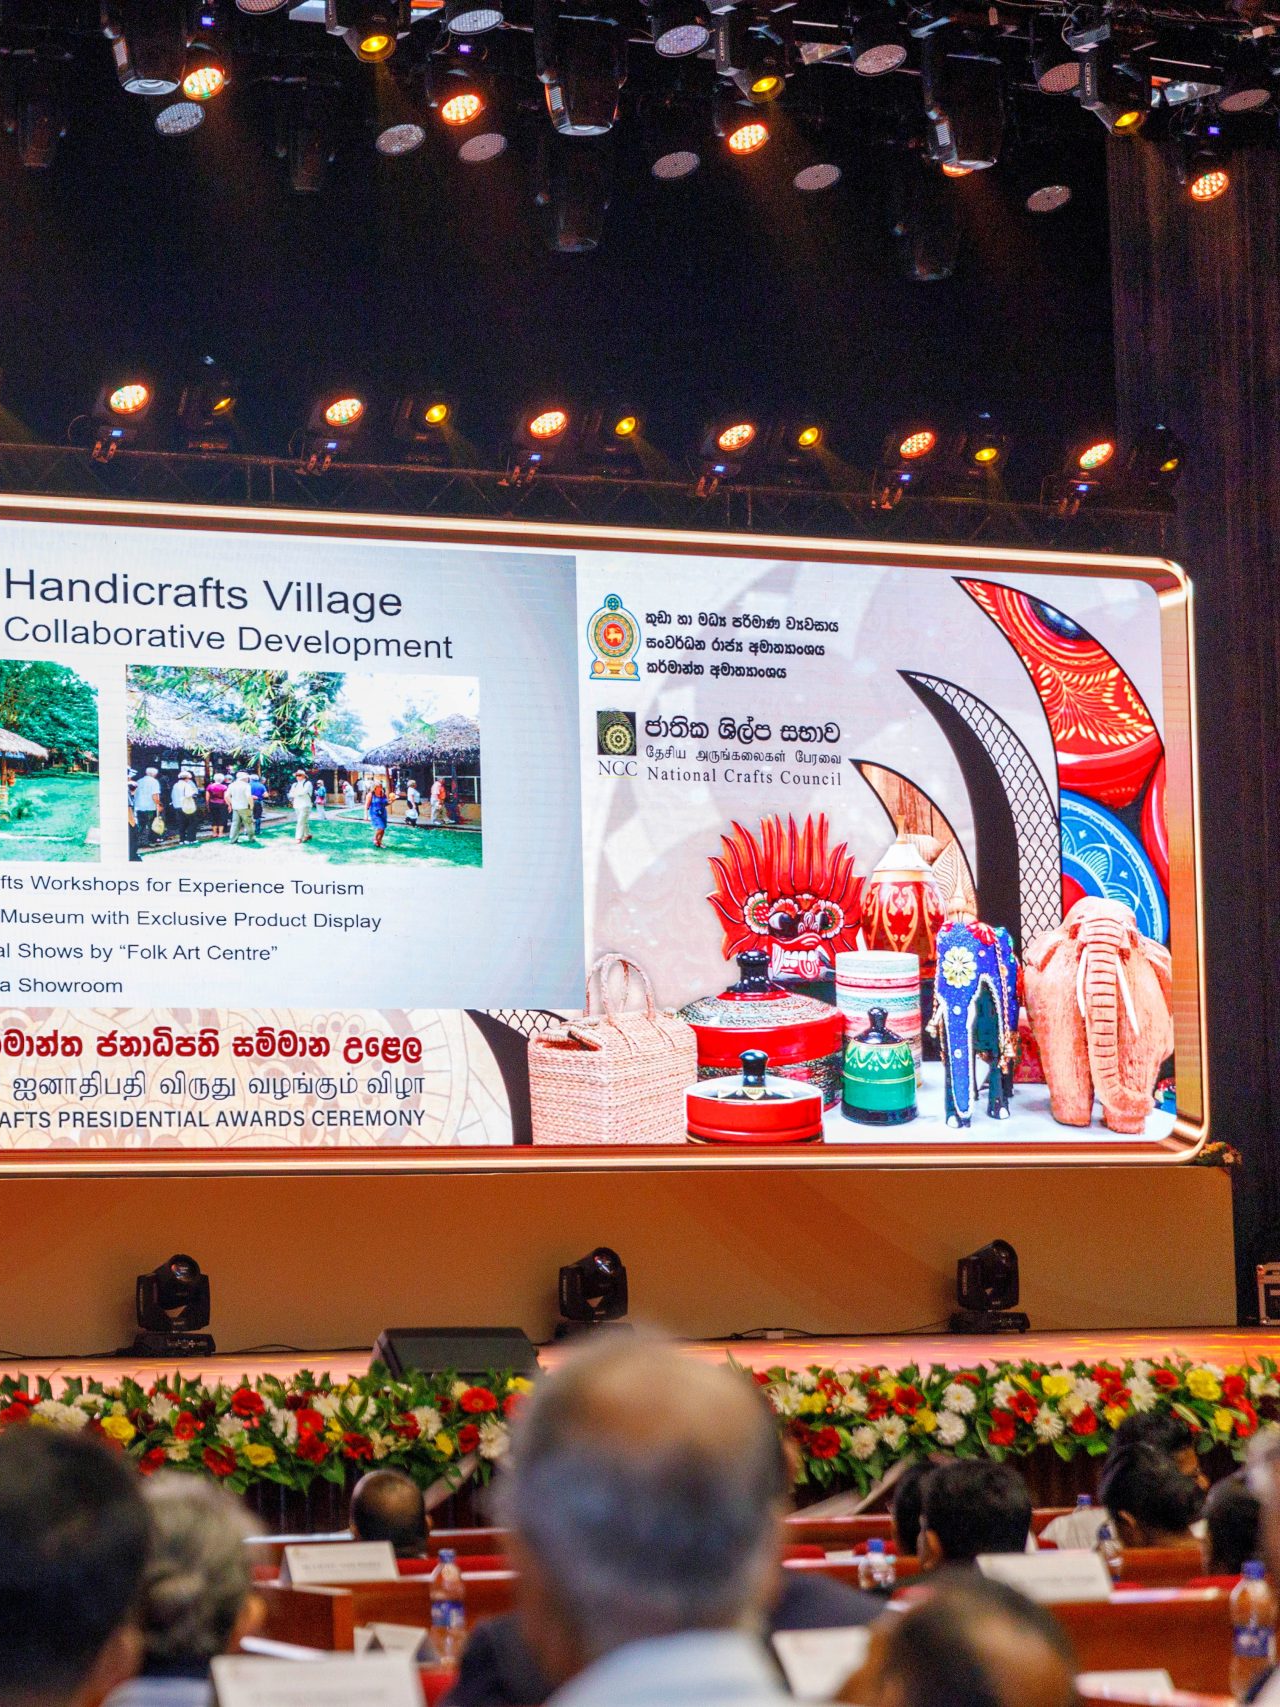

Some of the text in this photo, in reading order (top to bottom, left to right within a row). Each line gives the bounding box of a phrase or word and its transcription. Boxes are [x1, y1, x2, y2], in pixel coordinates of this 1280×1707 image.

[5, 568, 402, 622] Handicrafts Village
[4, 616, 453, 661] Collaborative Development
[645, 715, 841, 745] ජාතික ශිල්ප සභාව
[645, 745, 686, 762] தேசிய
[598, 760, 638, 777] NCC
[647, 767, 841, 787] National Crafts Council
[30, 875, 140, 895] Workshops
[146, 877, 172, 892] for
[178, 878, 285, 896] Experience
[290, 880, 364, 895] Tourism
[0, 909, 84, 925] Museum
[91, 910, 129, 925] with
[137, 910, 227, 926] Exclusive
[234, 912, 307, 928] Product
[313, 913, 381, 932] Display
[18, 943, 84, 959] Shows
[90, 944, 113, 963] by
[120, 944, 168, 960] “Folk
[172, 945, 201, 960] Art
[207, 945, 278, 961] Centre”
[18, 978, 123, 993] Showroom
[95, 1027, 220, 1058] ජනාධිපති
[232, 1027, 330, 1058] සම්මාන
[343, 1036, 423, 1064] උළෙල
[12, 1070, 146, 1101] ஜனாதிபதி
[159, 1070, 235, 1100] விருது
[248, 1072, 358, 1100] வழங்கும்
[367, 1070, 425, 1100] விழா
[59, 1110, 209, 1129] PRESIDENTIAL
[215, 1110, 305, 1128] AWARDS
[311, 1109, 426, 1127] CEREMONY
